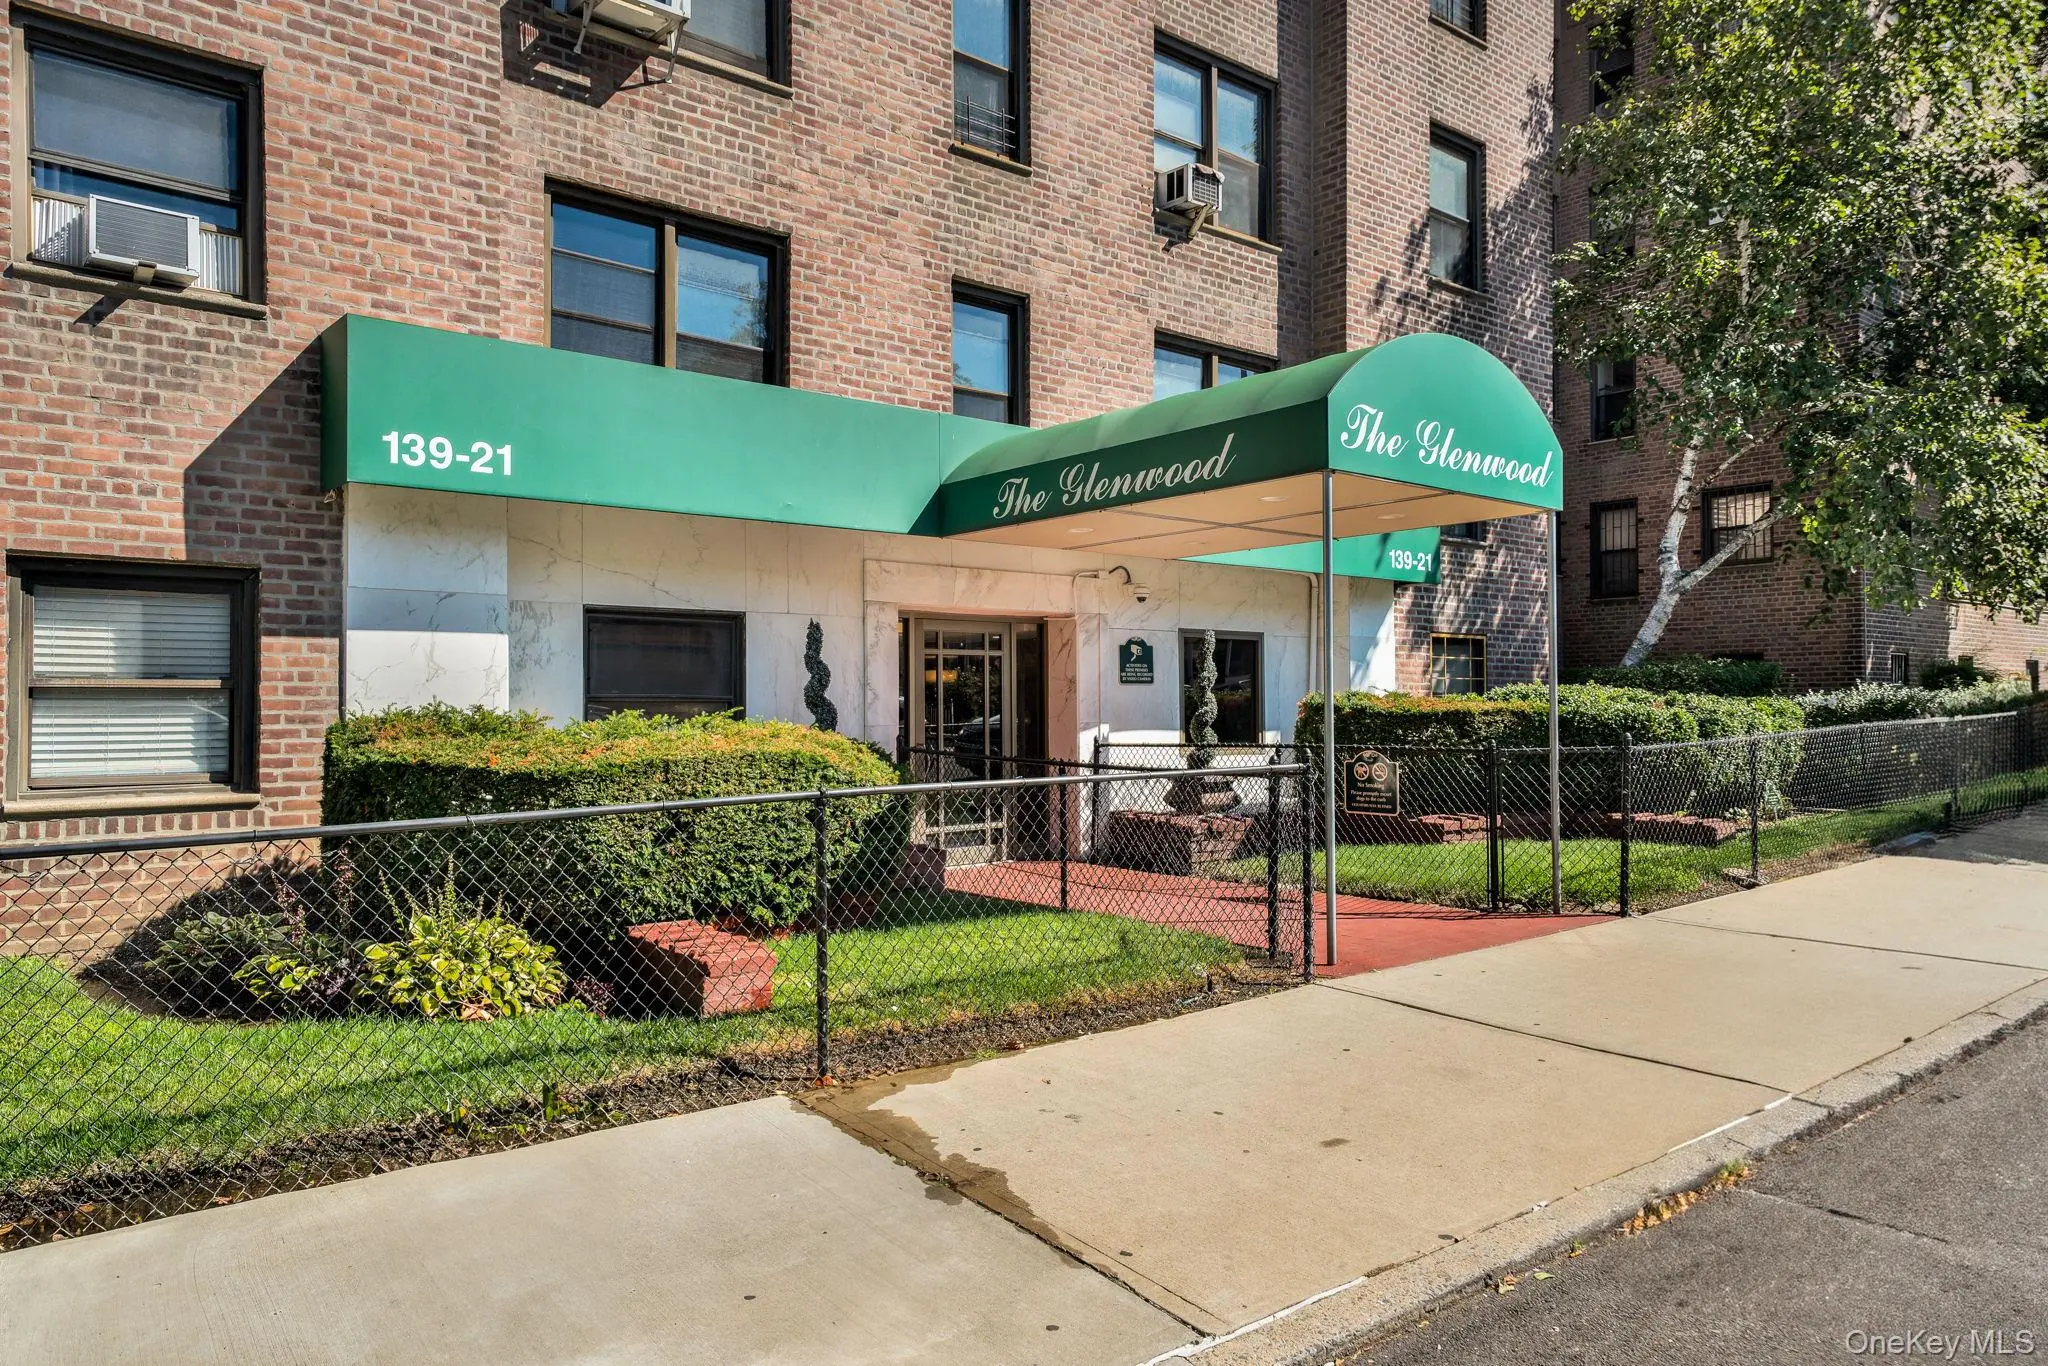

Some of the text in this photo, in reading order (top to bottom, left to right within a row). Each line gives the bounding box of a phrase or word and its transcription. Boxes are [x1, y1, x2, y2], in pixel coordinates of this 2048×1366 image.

[382, 430, 512, 476] 139-21
[1340, 404, 1553, 488] The Glenwood
[992, 432, 1237, 519] The Glenwood
[1389, 549, 1432, 572] 139-21
[1365, 782, 1385, 790] Smoking
